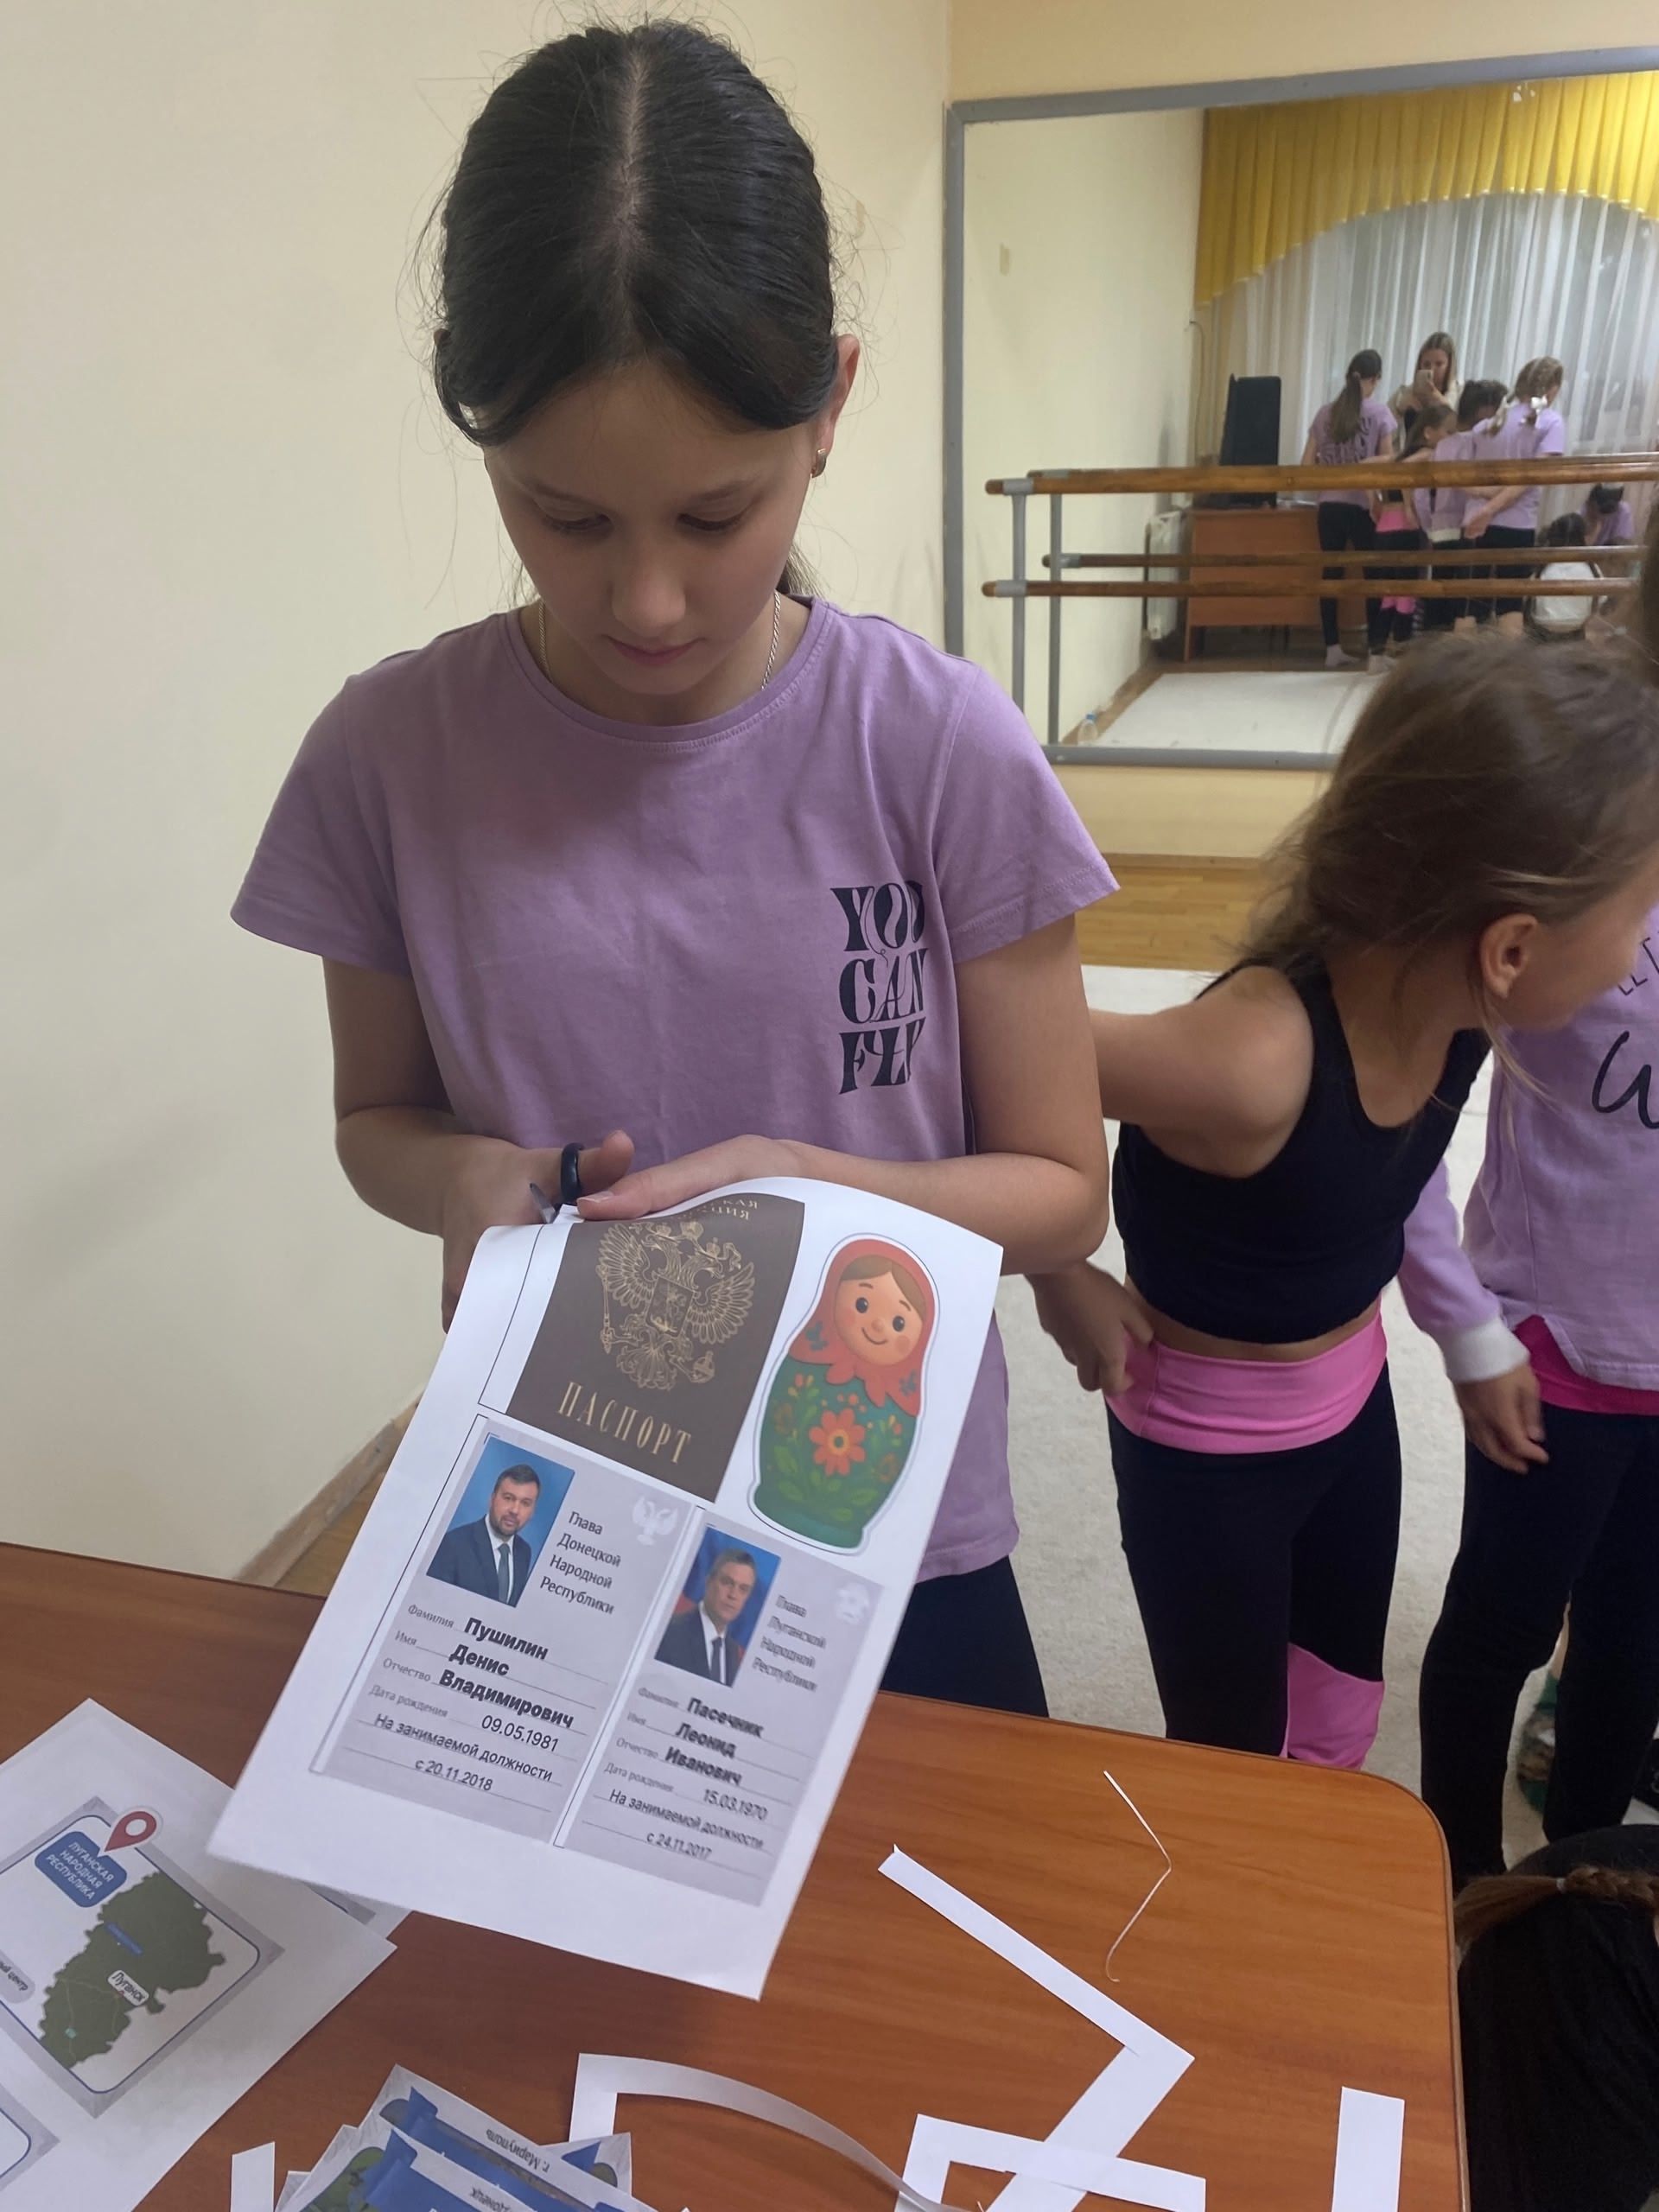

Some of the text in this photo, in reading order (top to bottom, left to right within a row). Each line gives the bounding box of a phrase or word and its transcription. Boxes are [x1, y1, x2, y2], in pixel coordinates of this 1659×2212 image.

[839, 948, 928, 1023] CAN
[839, 1017, 926, 1094] FLY
[557, 1381, 692, 1465] ПАСПОРТ
[569, 1511, 603, 1535] Глава
[556, 1533, 621, 1567] Донецкой
[550, 1554, 613, 1589] Народной
[540, 1576, 614, 1615] Республики
[395, 1630, 510, 1676] Имя Денис
[408, 1605, 549, 1661] Фамилия Пушилин
[383, 1658, 575, 1729] Отчество Владимирович
[369, 1685, 559, 1752] Дата рождения 09.05.1981
[687, 1697, 764, 1738] Пасечник
[374, 1713, 553, 1782] На занимаемой должности
[676, 1722, 736, 1758] Леонид
[415, 1759, 493, 1791] с 20.11.2018
[604, 1763, 627, 1777] Дата
[664, 1746, 742, 1787] Иванович
[609, 1789, 626, 1805] На
[646, 1833, 655, 1843] с
[46, 1854, 95, 1900] РЕСПУБЛИКА
[60, 1851, 103, 1890] НАРОДНАЯ
[69, 1841, 115, 1883] ЛУГАНСКАЯ
[111, 1971, 146, 2002] Луганск
[486, 2128, 542, 2171] Мариуполь
